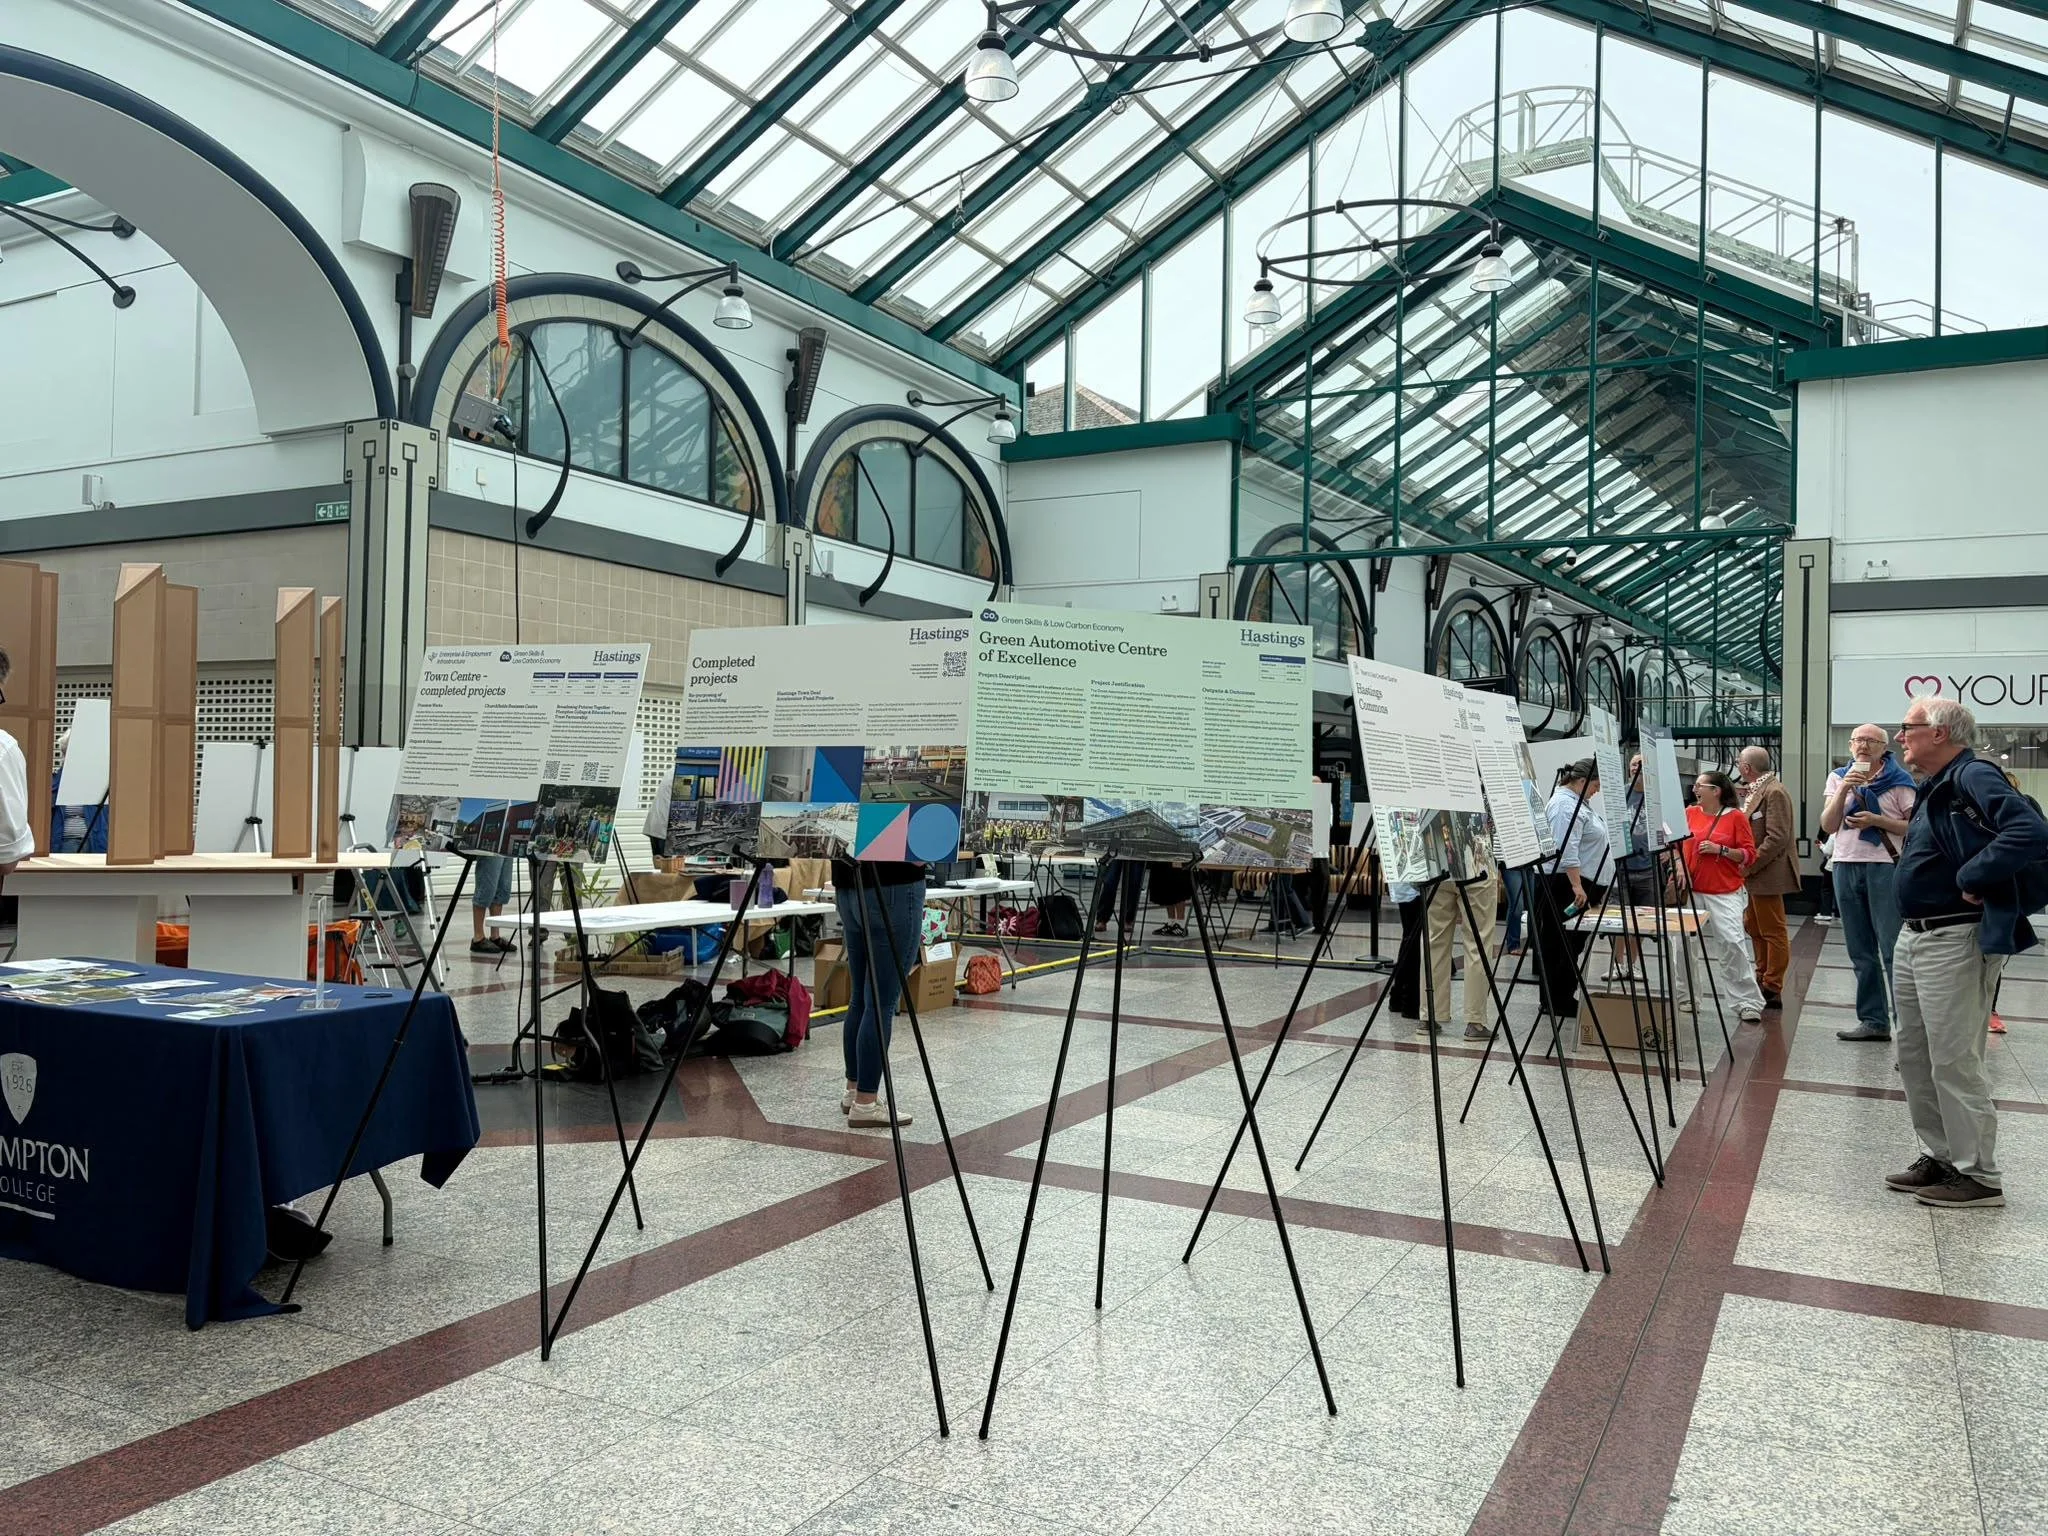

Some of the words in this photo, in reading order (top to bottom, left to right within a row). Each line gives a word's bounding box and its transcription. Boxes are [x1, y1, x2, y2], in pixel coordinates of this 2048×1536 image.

[1001, 616, 1024, 624] Green
[1024, 617, 1042, 626] Skills
[1043, 619, 1049, 627] &
[1050, 620, 1064, 628] Low
[1065, 621, 1091, 630] Carbon
[1092, 622, 1125, 633] Economy
[909, 627, 969, 642] Hastings
[1240, 629, 1305, 648] Hastings
[979, 631, 1025, 647] Green
[1029, 635, 1115, 654] Automotive
[1118, 641, 1168, 657] Centre
[593, 650, 642, 665] Hastings
[692, 655, 756, 671] Completed
[979, 650, 995, 662] of
[997, 650, 1077, 668] Excellence
[424, 671, 449, 681] Town
[450, 671, 481, 682] Centre
[690, 673, 738, 687] projects
[420, 685, 466, 698] completed
[468, 685, 507, 698] projects
[1356, 682, 1384, 700] Hastings
[1359, 698, 1389, 714] Commons
[6, 1074, 33, 1094] 1926
